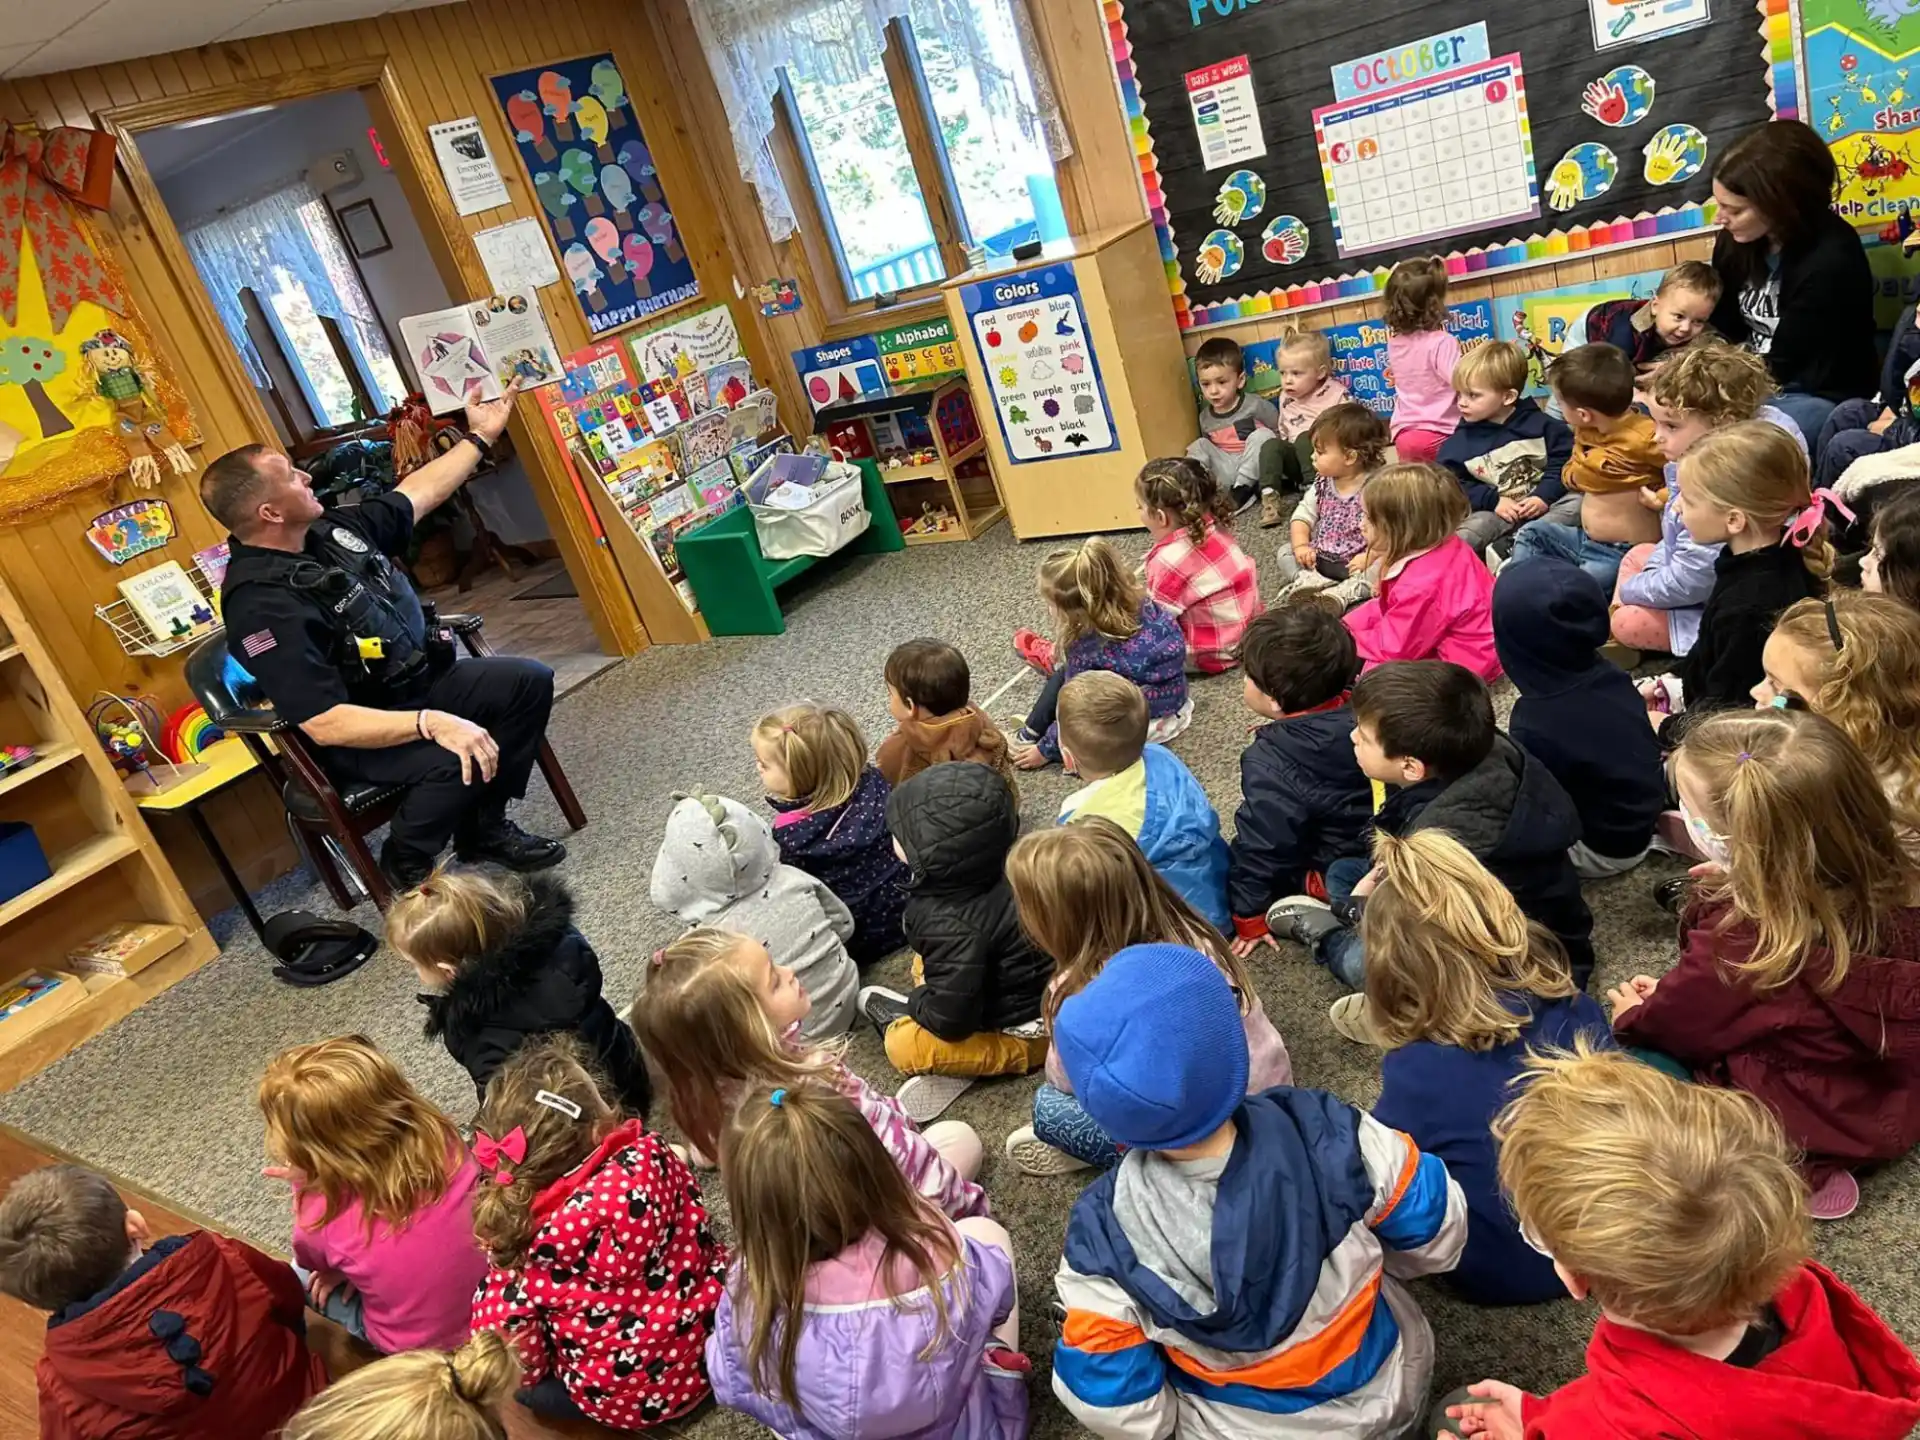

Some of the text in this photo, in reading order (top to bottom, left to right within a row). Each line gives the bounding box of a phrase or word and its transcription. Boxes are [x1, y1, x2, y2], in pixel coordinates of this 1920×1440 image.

[1874, 106, 1920, 131] Shar
[995, 282, 1040, 301] Colors
[588, 280, 700, 333] HAPPY BIRTHDAY
[981, 300, 1072, 327] red orange blue
[895, 323, 949, 346] Alphabet
[816, 346, 852, 362] Shapes
[1060, 340, 1082, 354] pink
[1347, 352, 1375, 372] have
[1000, 381, 1093, 406] green purple grey
[1353, 374, 1380, 391] can
[1024, 418, 1087, 437] brown black
[95, 501, 149, 528] MATH
[841, 501, 862, 525] BOOK
